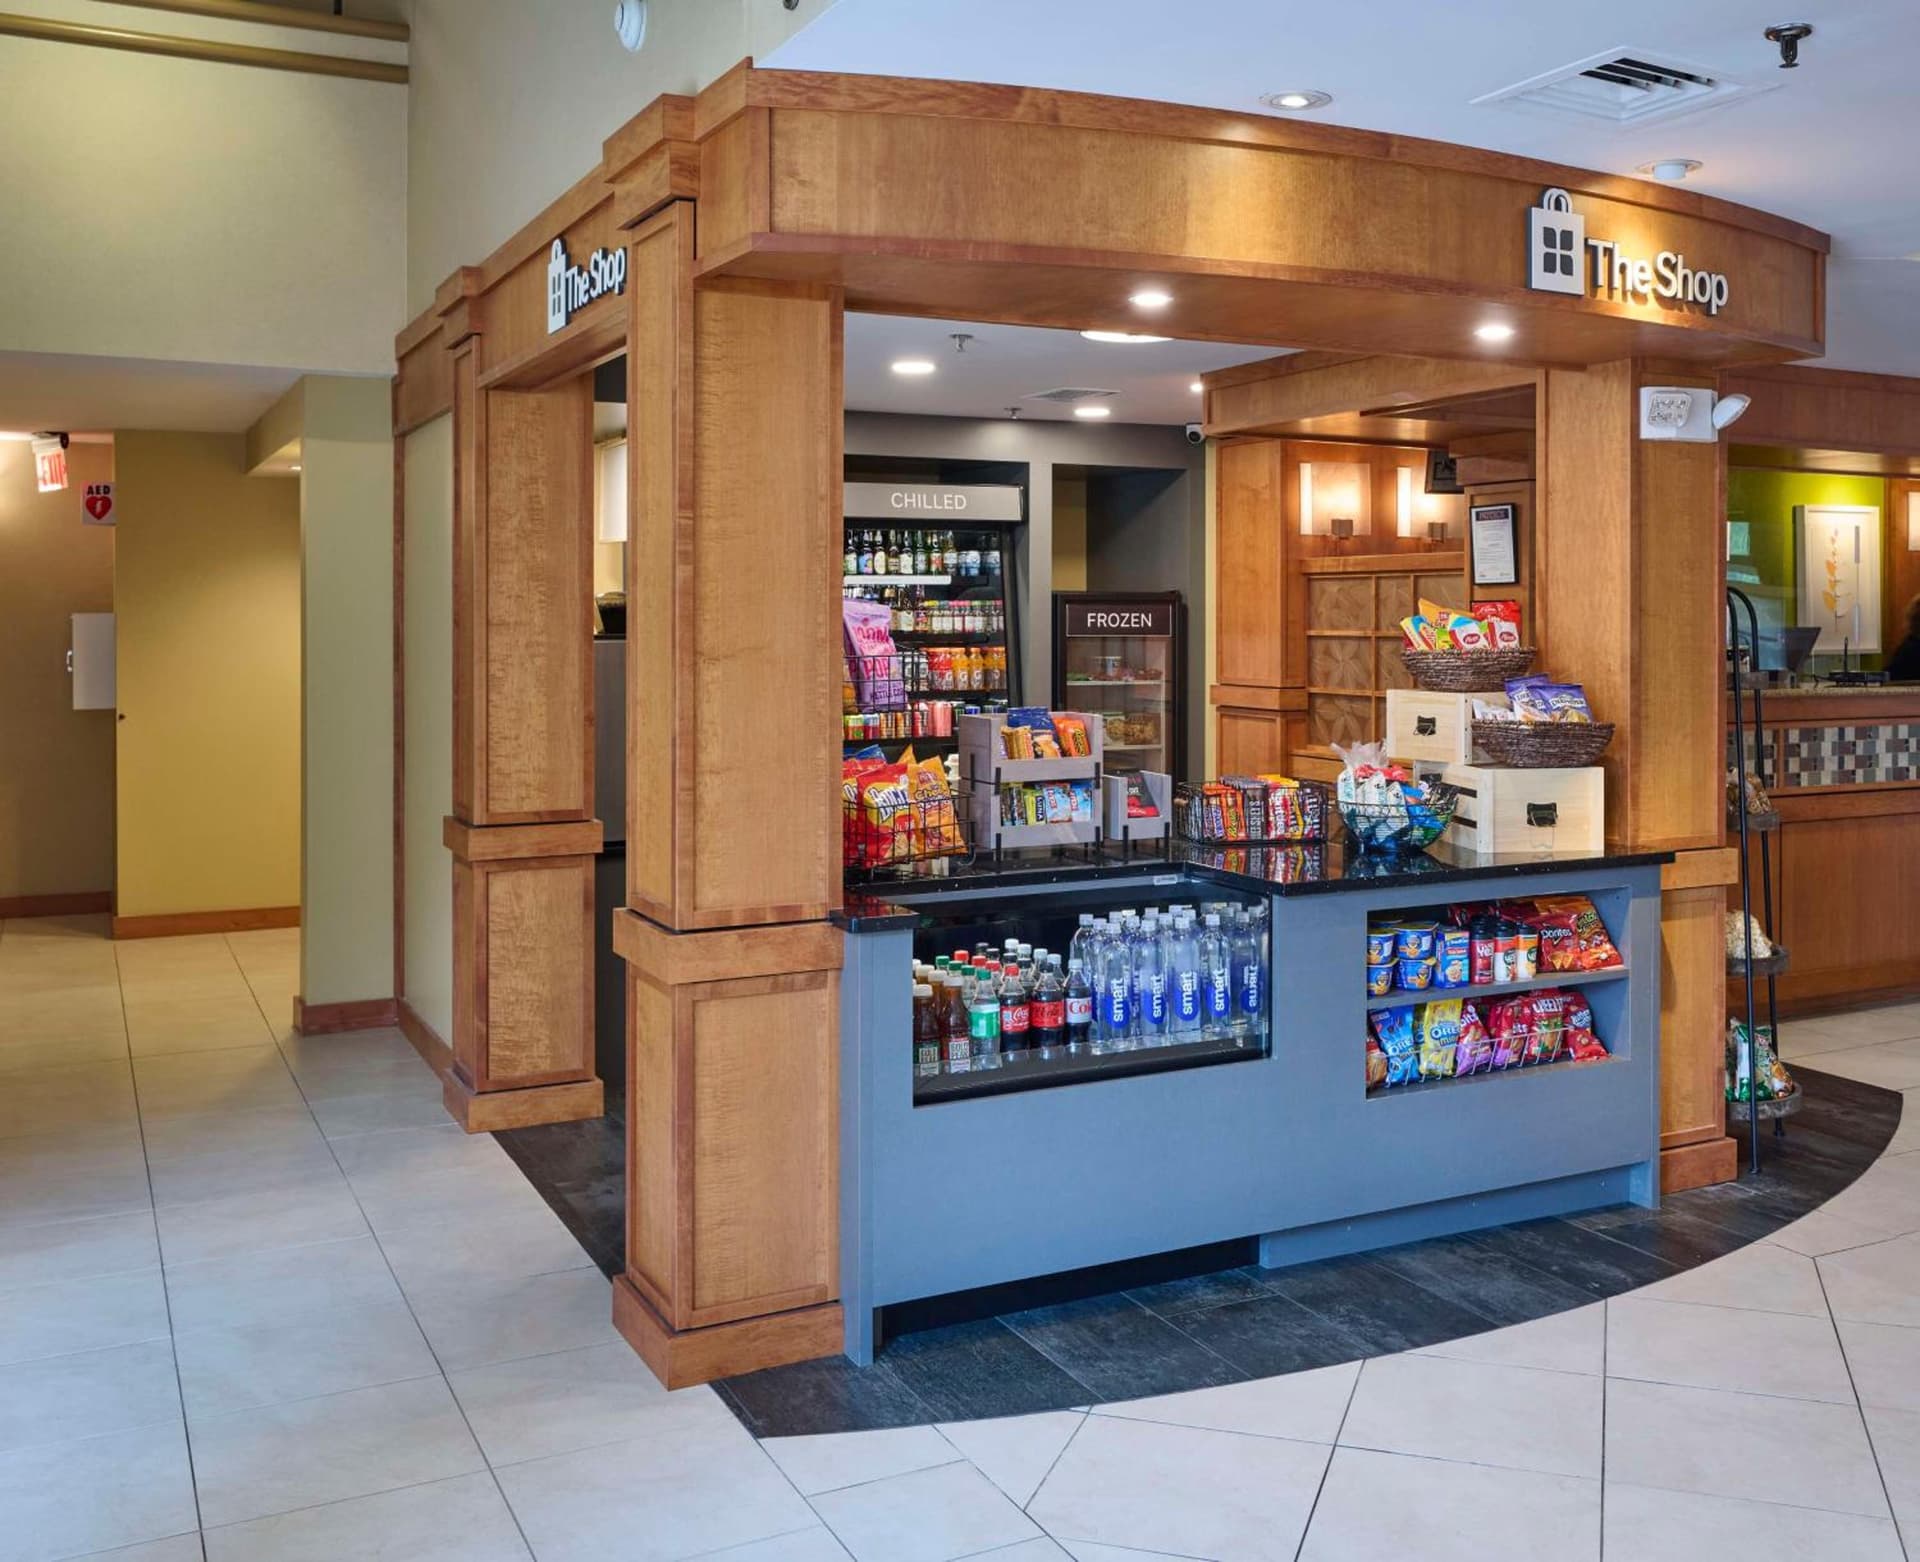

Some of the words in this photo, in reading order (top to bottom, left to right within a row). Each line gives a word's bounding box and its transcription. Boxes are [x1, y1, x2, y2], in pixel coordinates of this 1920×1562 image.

[565, 265, 590, 313] The
[589, 247, 626, 299] Shop
[1587, 238, 1651, 294] The
[1655, 250, 1729, 315] Shop
[87, 485, 111, 496] AED
[890, 492, 967, 510] CHILLED
[1086, 611, 1152, 628] FROZEN
[1541, 928, 1572, 939] Doritos
[1112, 977, 1124, 1022] smart
[1151, 974, 1163, 1018] smart
[1181, 971, 1193, 1015] smart
[1213, 969, 1225, 1011] smart
